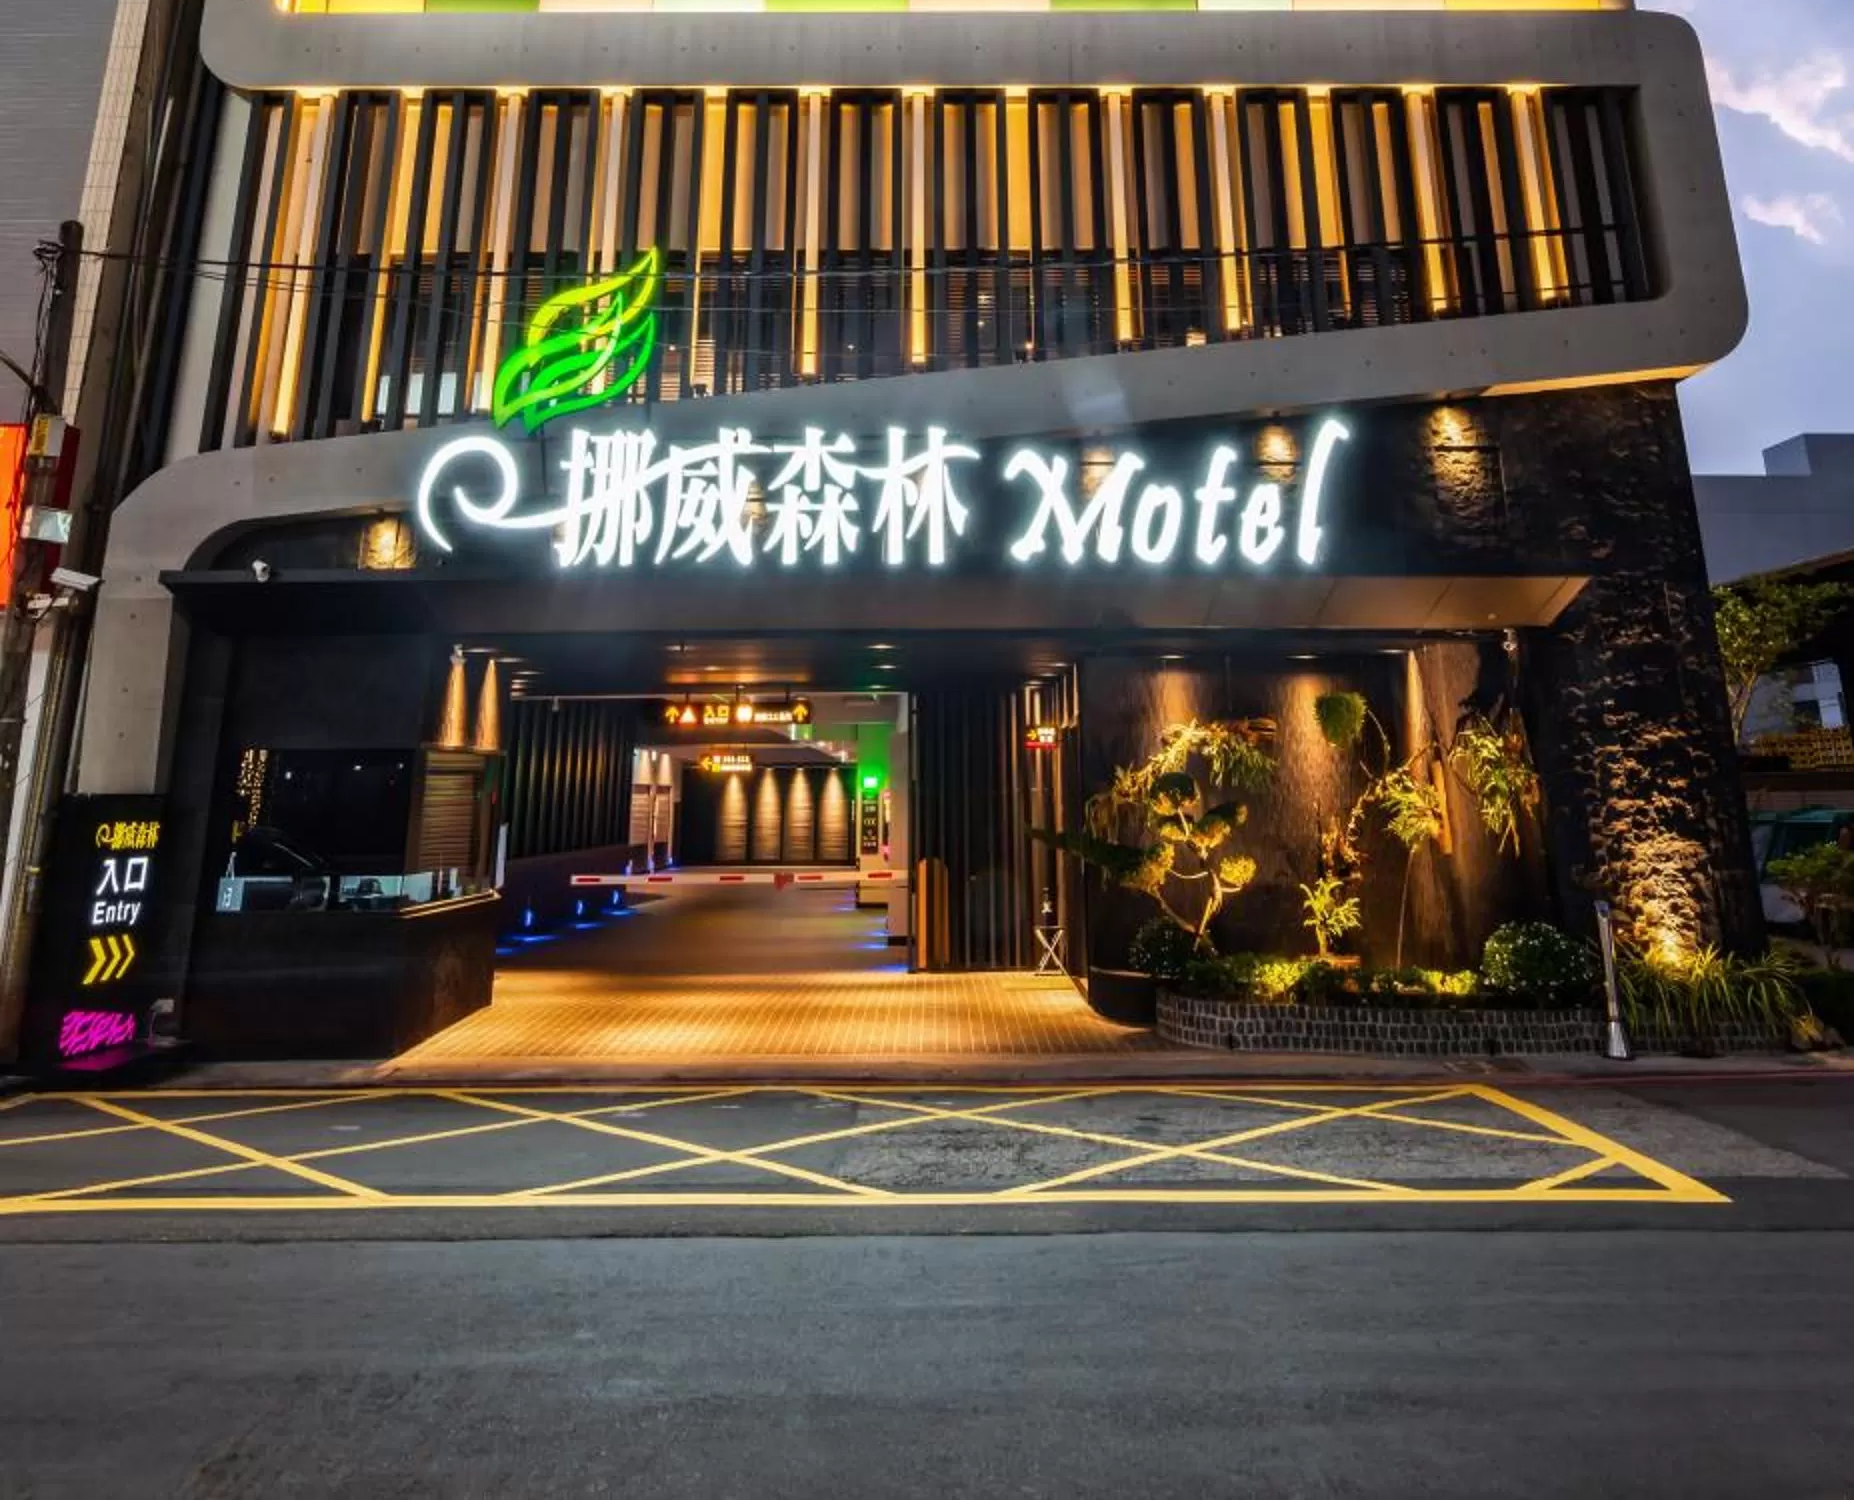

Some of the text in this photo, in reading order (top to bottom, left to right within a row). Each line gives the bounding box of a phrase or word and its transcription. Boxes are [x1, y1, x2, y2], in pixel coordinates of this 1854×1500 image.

[419, 417, 1350, 567] 挪威森林 Motel
[96, 856, 148, 896] 入口
[92, 900, 141, 925] Entry
